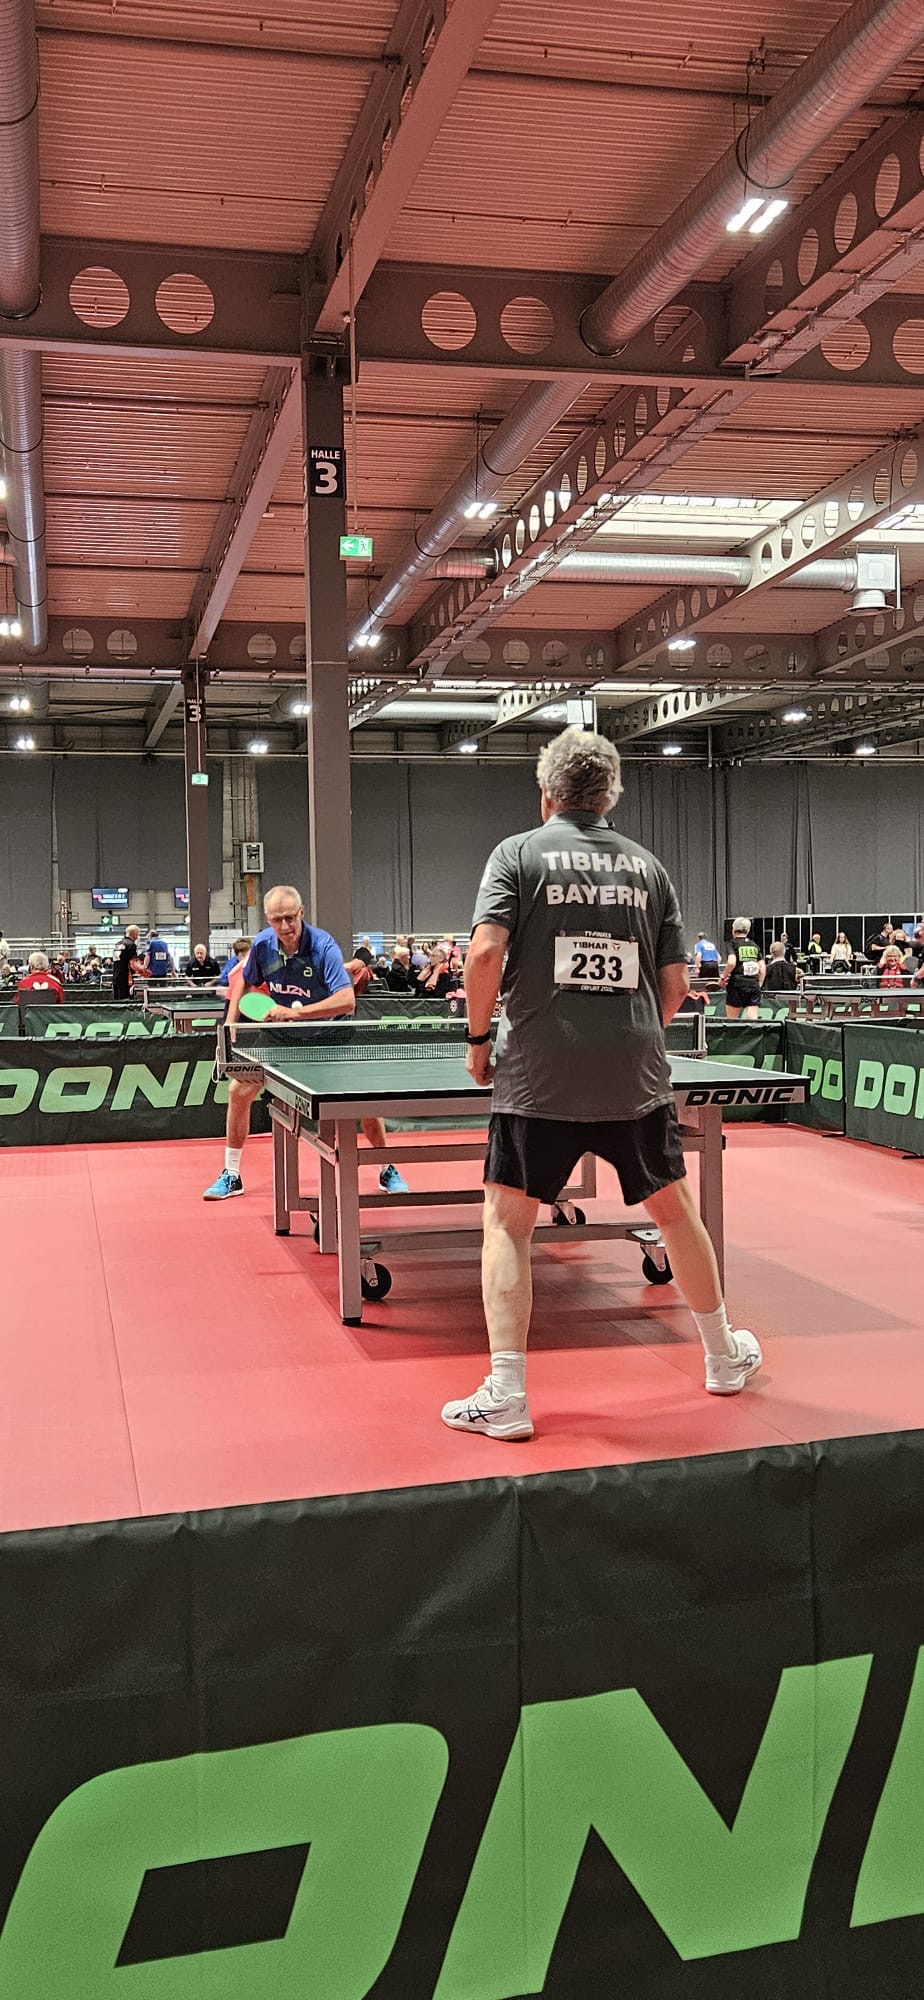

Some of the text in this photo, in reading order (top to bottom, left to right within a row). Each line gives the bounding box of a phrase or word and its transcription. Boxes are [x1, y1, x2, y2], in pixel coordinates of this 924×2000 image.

[311, 449, 341, 460] HALLE
[315, 461, 338, 494] 3
[189, 704, 202, 722] 3
[541, 851, 648, 878] TIBHAR
[546, 883, 648, 911] BAYERN
[573, 941, 609, 950] TIBHAR
[570, 953, 623, 982] 233
[225, 1065, 263, 1073] DONIC
[685, 1087, 797, 1107] DONIC
